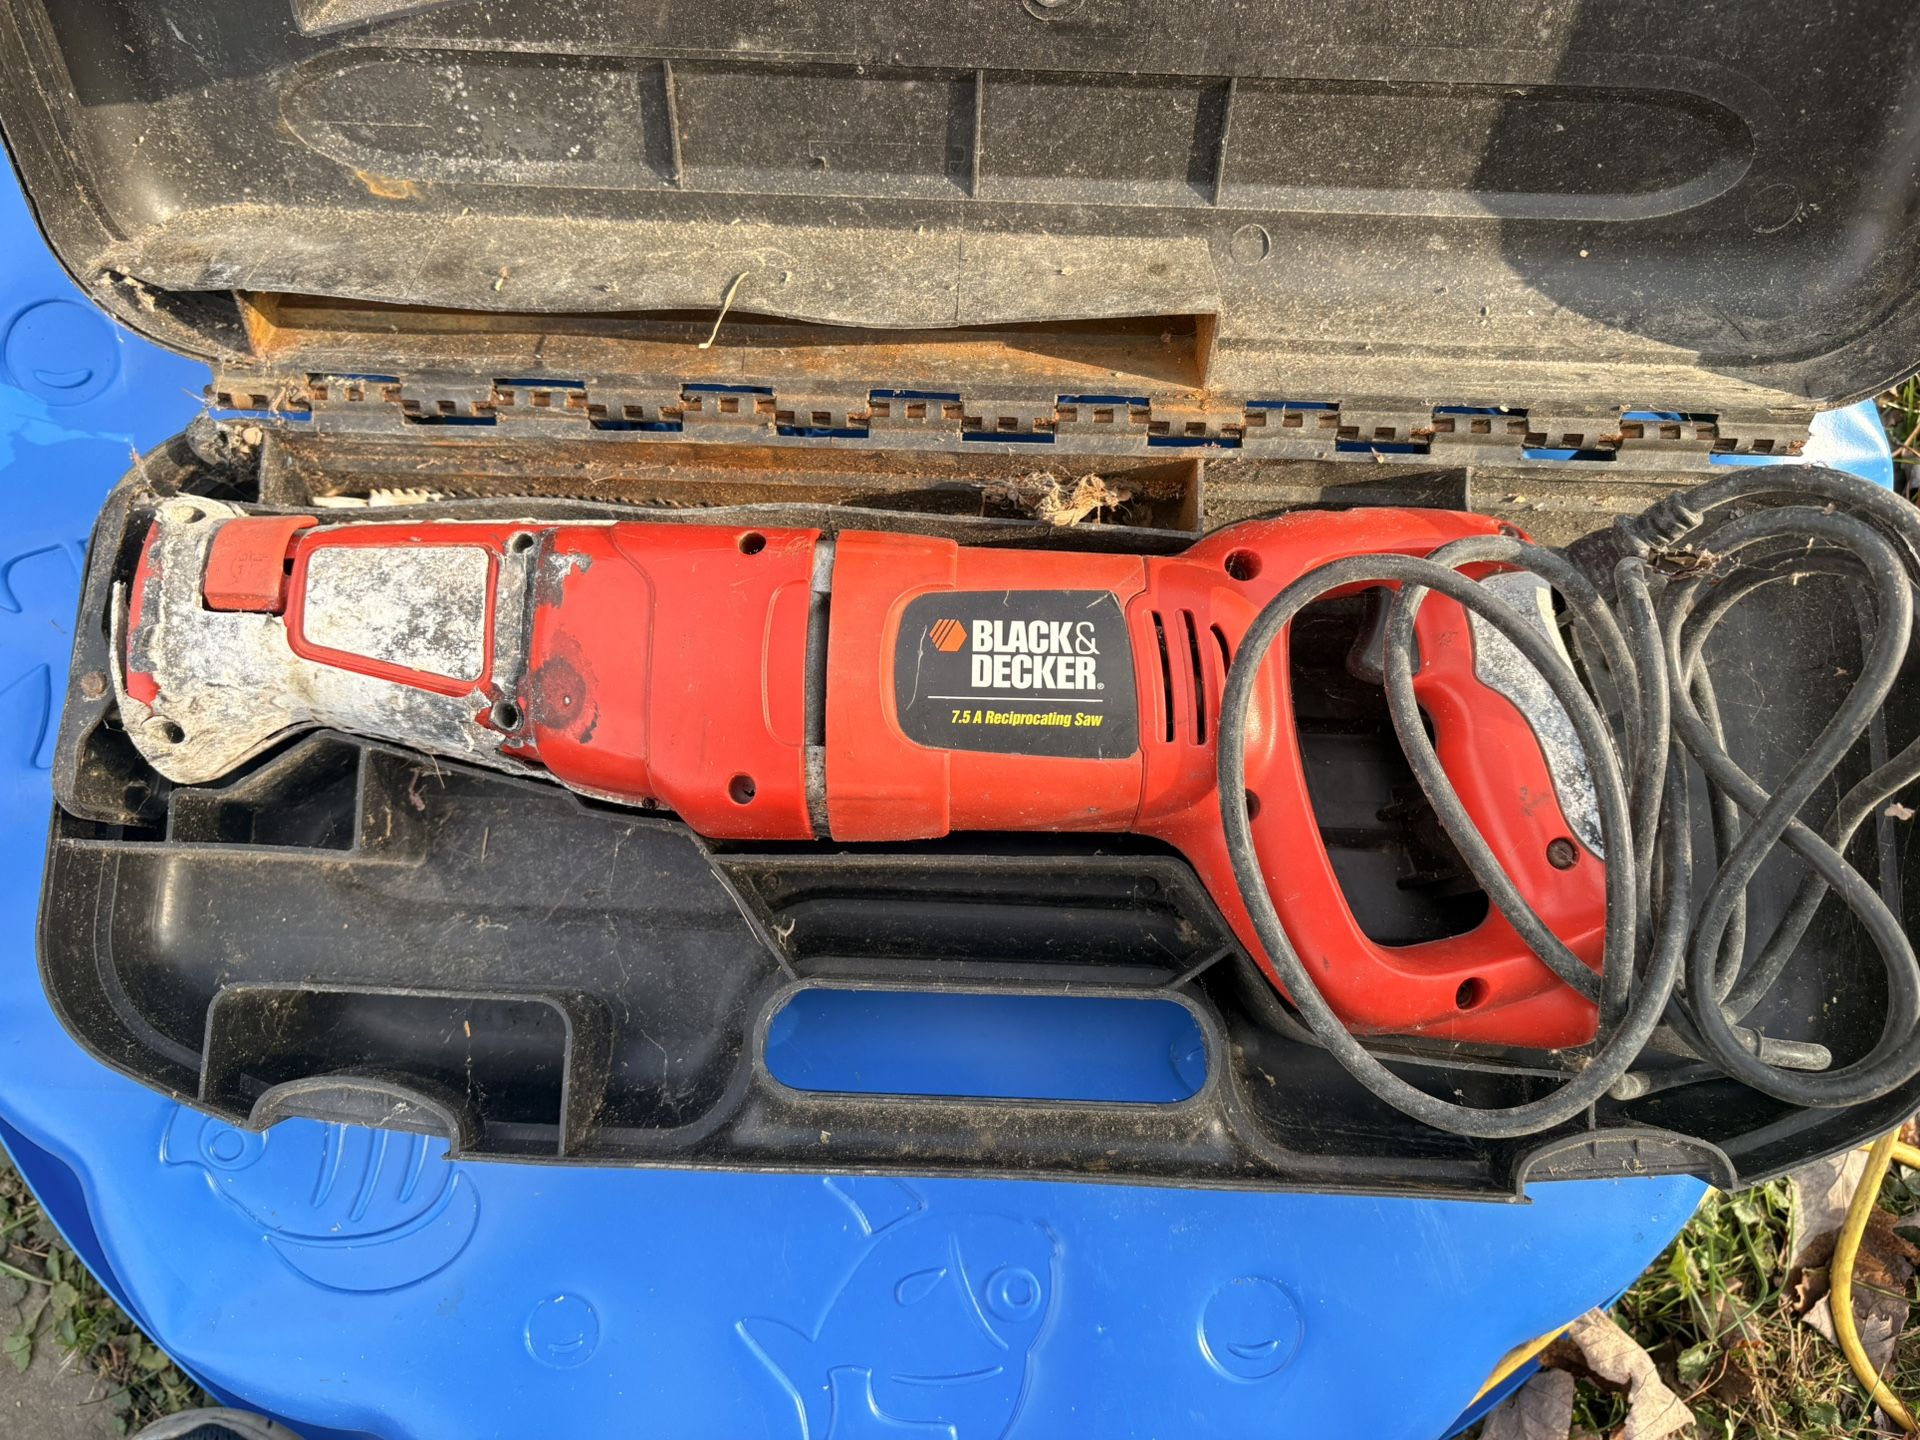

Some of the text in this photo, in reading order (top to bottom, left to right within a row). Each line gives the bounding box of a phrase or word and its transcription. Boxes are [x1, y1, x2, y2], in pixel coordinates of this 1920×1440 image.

[951, 710, 1103, 727] 7.5 A Reciprocating Saw
